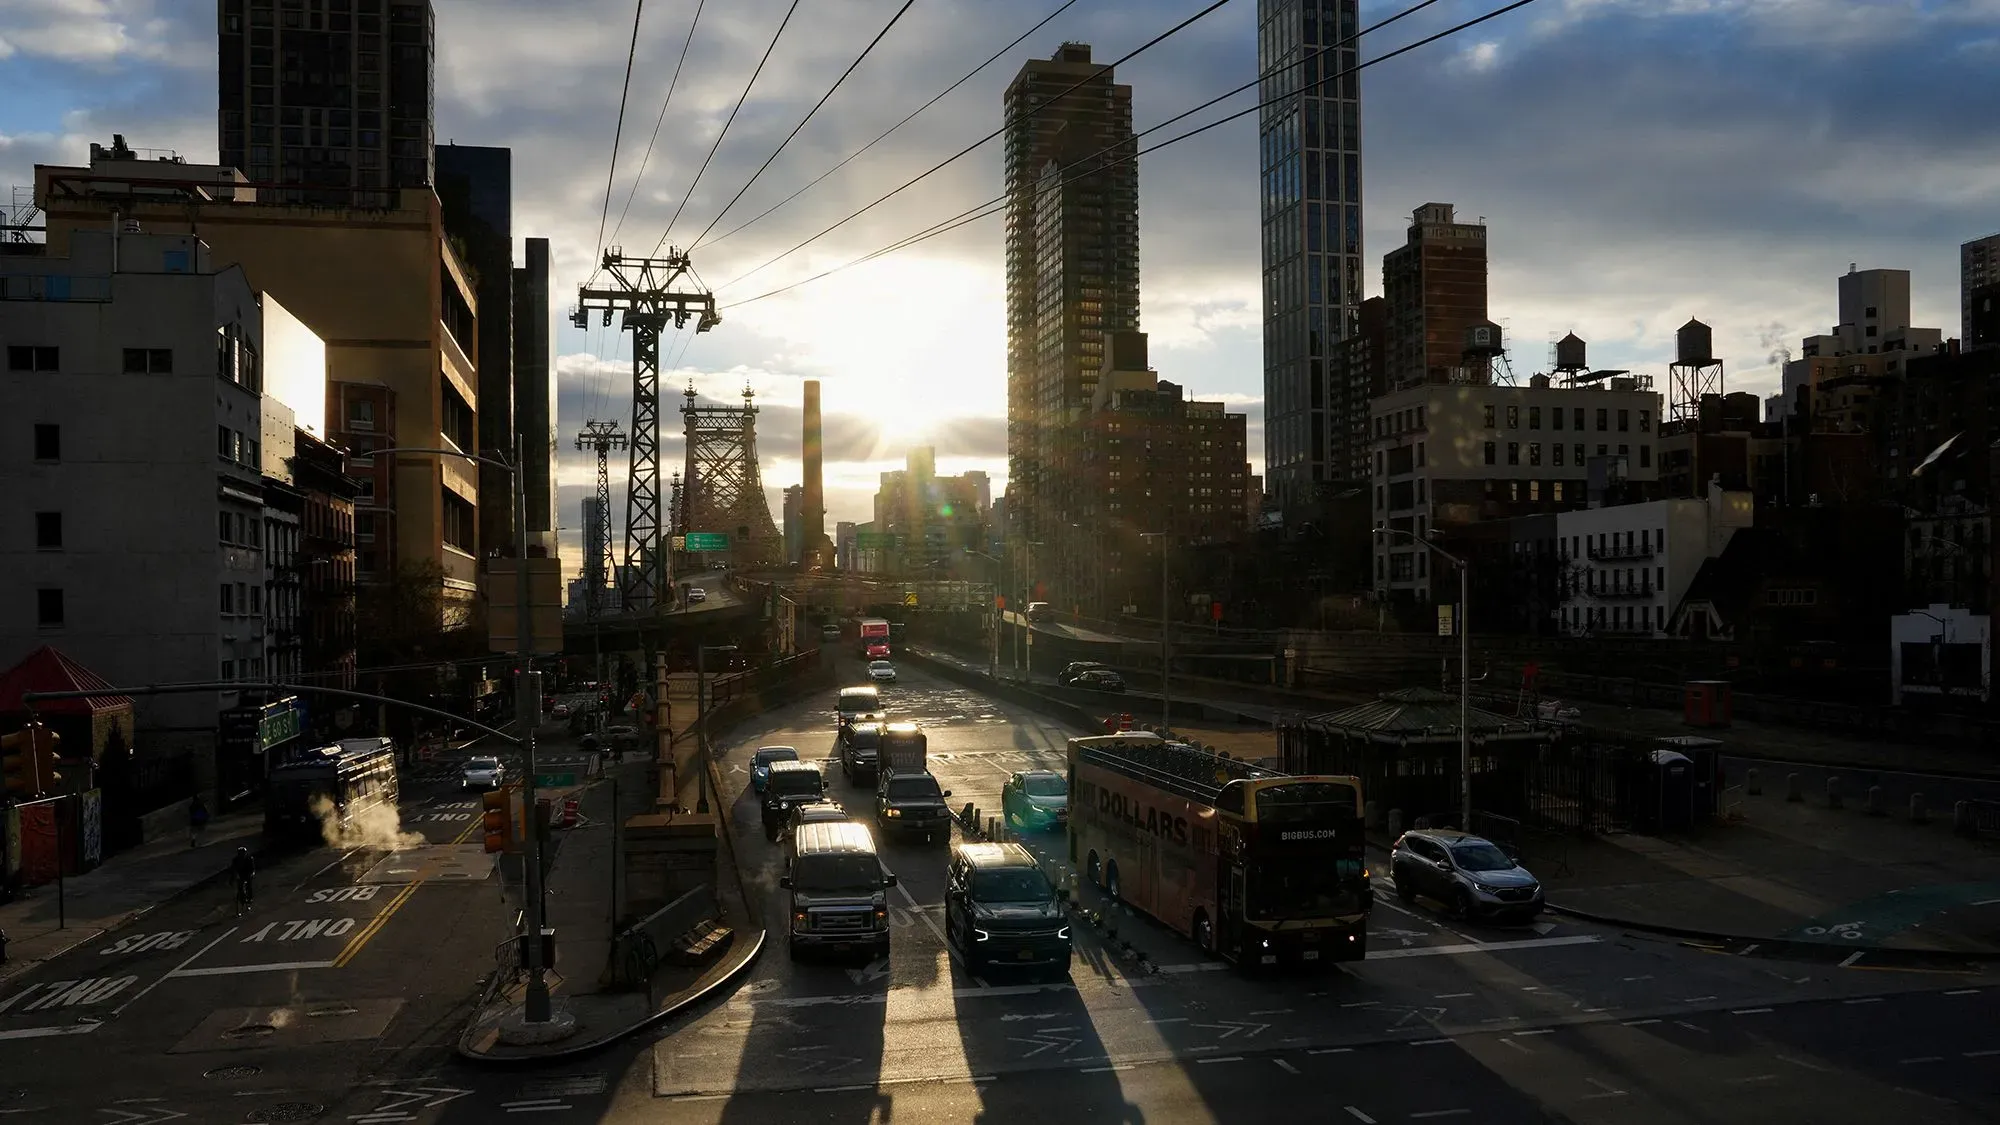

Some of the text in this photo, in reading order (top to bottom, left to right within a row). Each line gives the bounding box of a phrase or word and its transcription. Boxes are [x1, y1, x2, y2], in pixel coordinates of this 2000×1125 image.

[273, 721, 281, 738] 60
[546, 775, 555, 786] 2
[433, 802, 478, 810] BUS
[409, 813, 472, 823] ONLY
[1100, 786, 1188, 846] DOLLARS
[1281, 829, 1336, 841] BIGBUS.COM
[304, 885, 382, 904] BUS
[240, 917, 356, 943] ONLY
[99, 929, 202, 956] BUS
